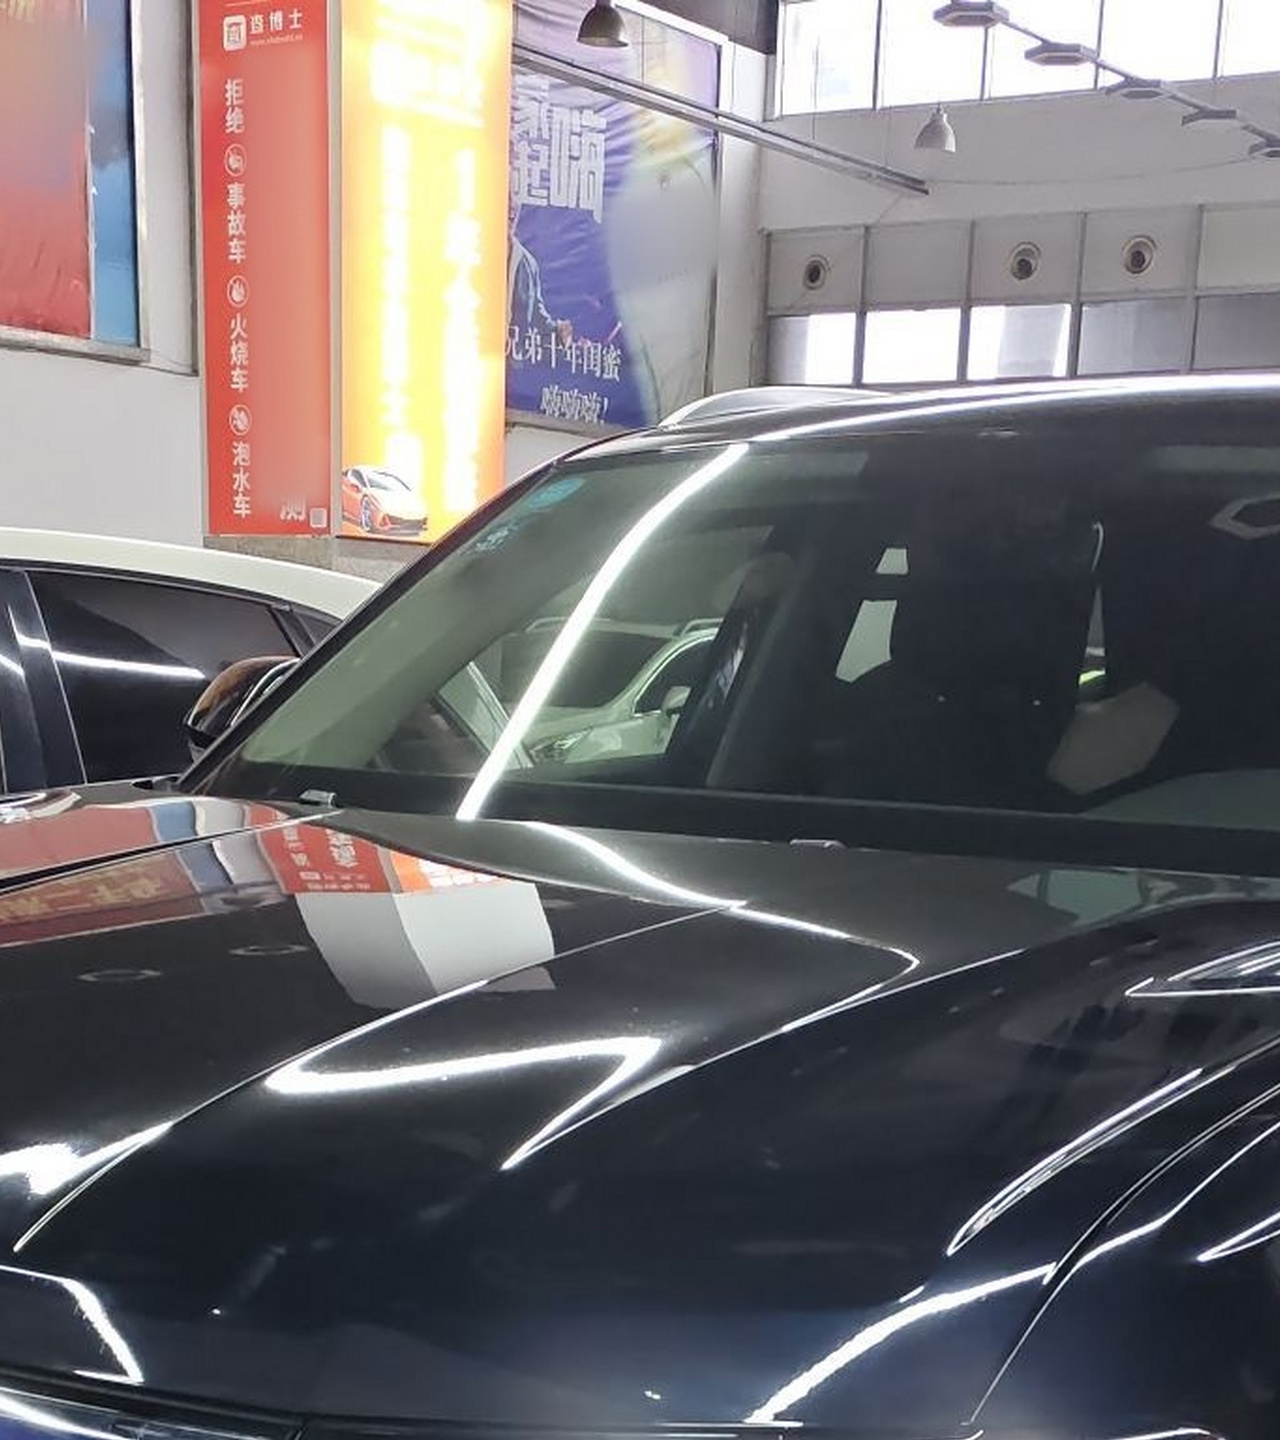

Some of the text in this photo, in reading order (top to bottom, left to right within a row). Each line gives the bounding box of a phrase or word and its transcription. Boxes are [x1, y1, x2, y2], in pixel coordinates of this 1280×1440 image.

[250, 8, 303, 34] 查博士
[225, 78, 252, 519] 拒绝 事故车 火烧车 泡水车
